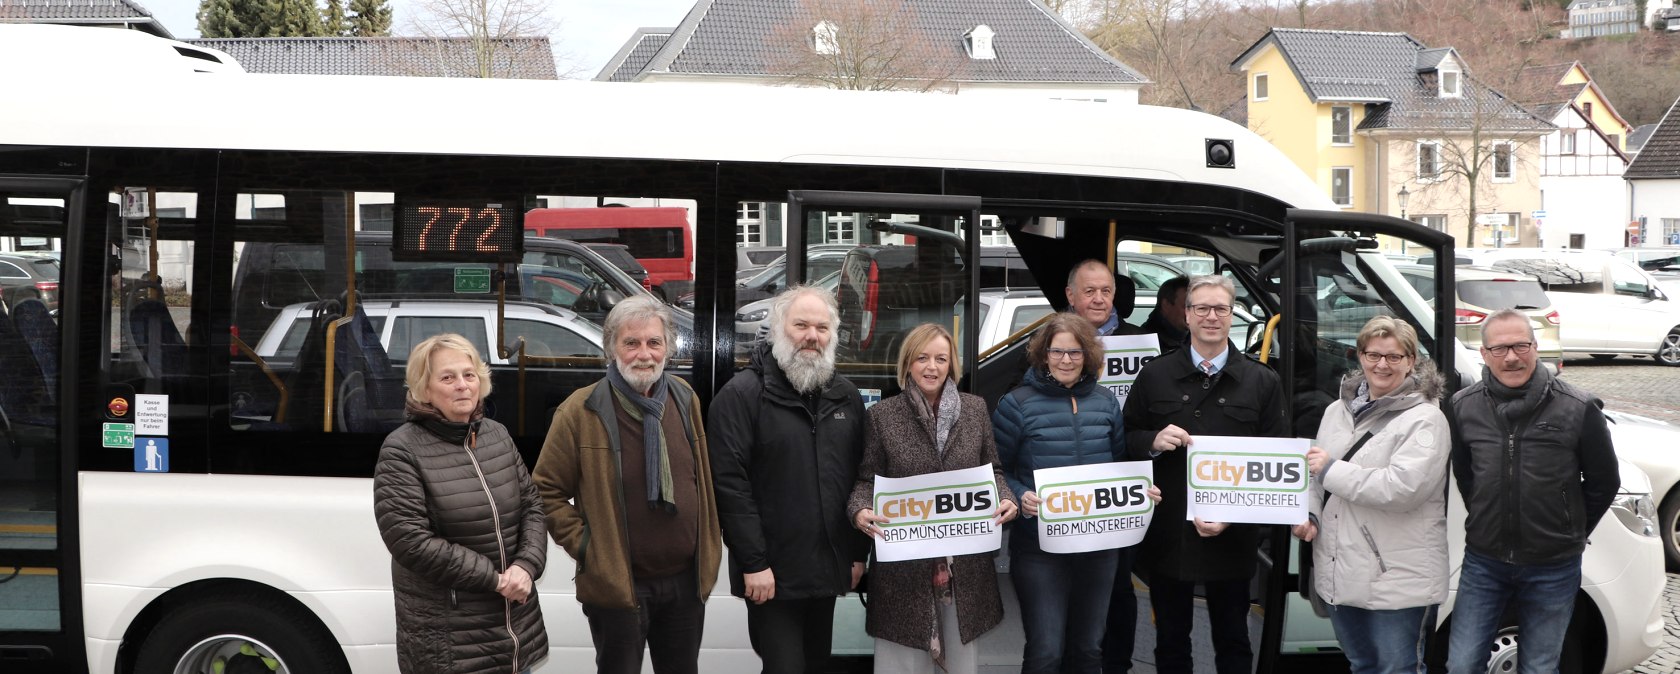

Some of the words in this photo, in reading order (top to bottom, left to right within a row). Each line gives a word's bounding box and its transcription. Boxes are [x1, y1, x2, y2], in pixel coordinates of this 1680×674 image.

[418, 207, 500, 251] 772
[1195, 460, 1301, 486] CityBUS
[882, 490, 992, 519] CityBUS
[1046, 484, 1146, 515] CityBUS
[1195, 491, 1218, 503] BAD
[1220, 491, 1300, 507] MÜNSTEREIFEL
[884, 528, 908, 541] BAD
[910, 521, 993, 539] MÜNSTEREIFEL
[1046, 523, 1069, 535] BAD
[1071, 516, 1145, 534] MÜNSTEREIFEL
